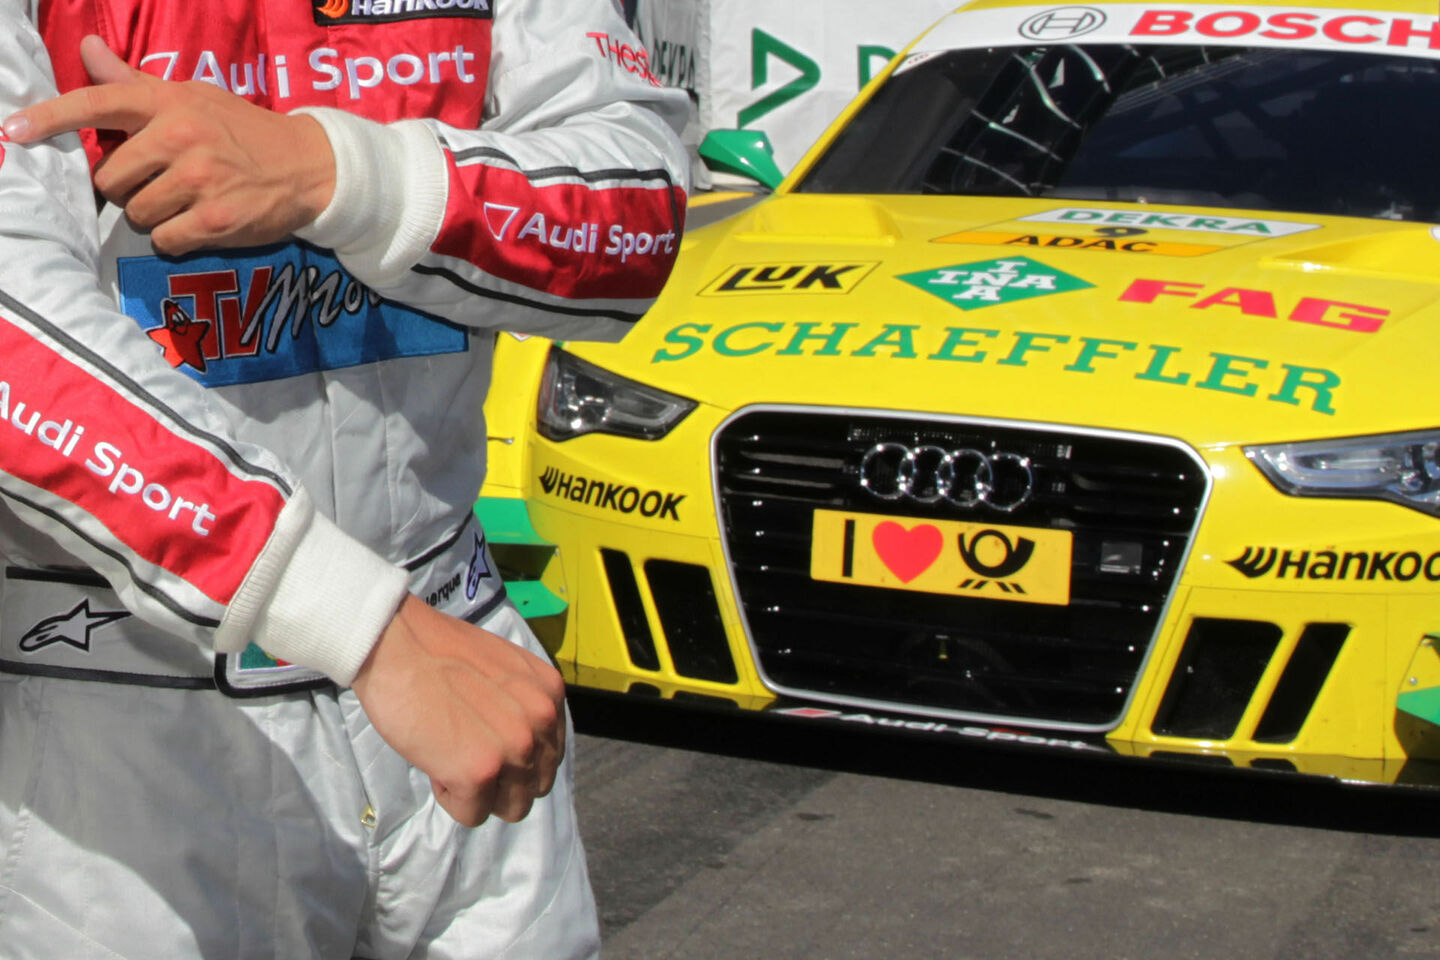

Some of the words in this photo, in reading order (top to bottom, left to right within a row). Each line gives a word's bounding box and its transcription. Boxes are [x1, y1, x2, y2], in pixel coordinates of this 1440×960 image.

[1129, 10, 1440, 49] BOSCH
[310, 44, 476, 100] Sport
[857, 44, 898, 93] D
[517, 212, 599, 253] Audi
[605, 224, 676, 263] Sport
[1005, 234, 1159, 253] ADAC
[1058, 209, 1273, 234] DEKRA
[167, 265, 273, 361] TV
[1117, 278, 1392, 334] FAG
[651, 321, 1342, 416] SCHAEFFLER
[84, 437, 218, 538] Sport
[841, 518, 856, 579] I
[841, 713, 949, 733] Audi
[958, 726, 1088, 750] Sport
